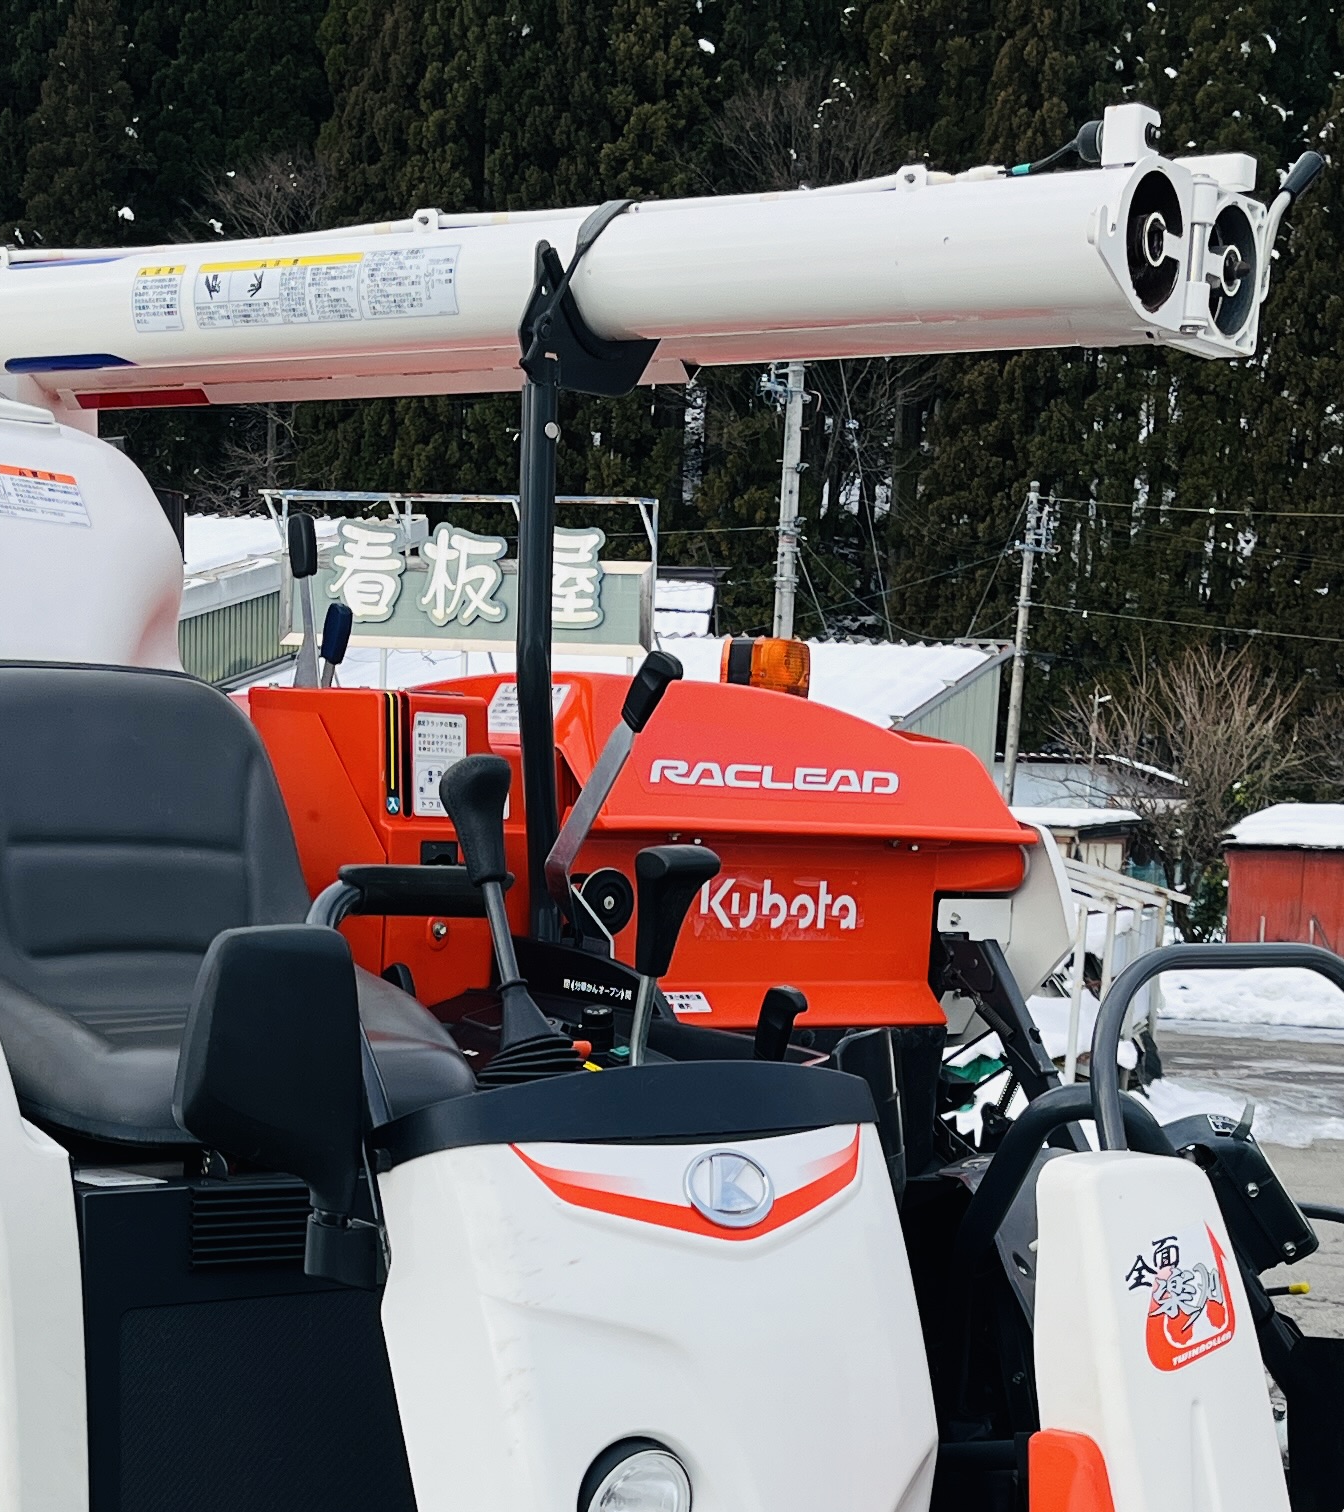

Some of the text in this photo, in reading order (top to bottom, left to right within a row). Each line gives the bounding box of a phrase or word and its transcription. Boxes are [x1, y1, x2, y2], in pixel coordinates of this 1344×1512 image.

[329, 523, 600, 624] 看板屋
[649, 759, 899, 794] RACLEAD
[700, 878, 857, 929] Kubota
